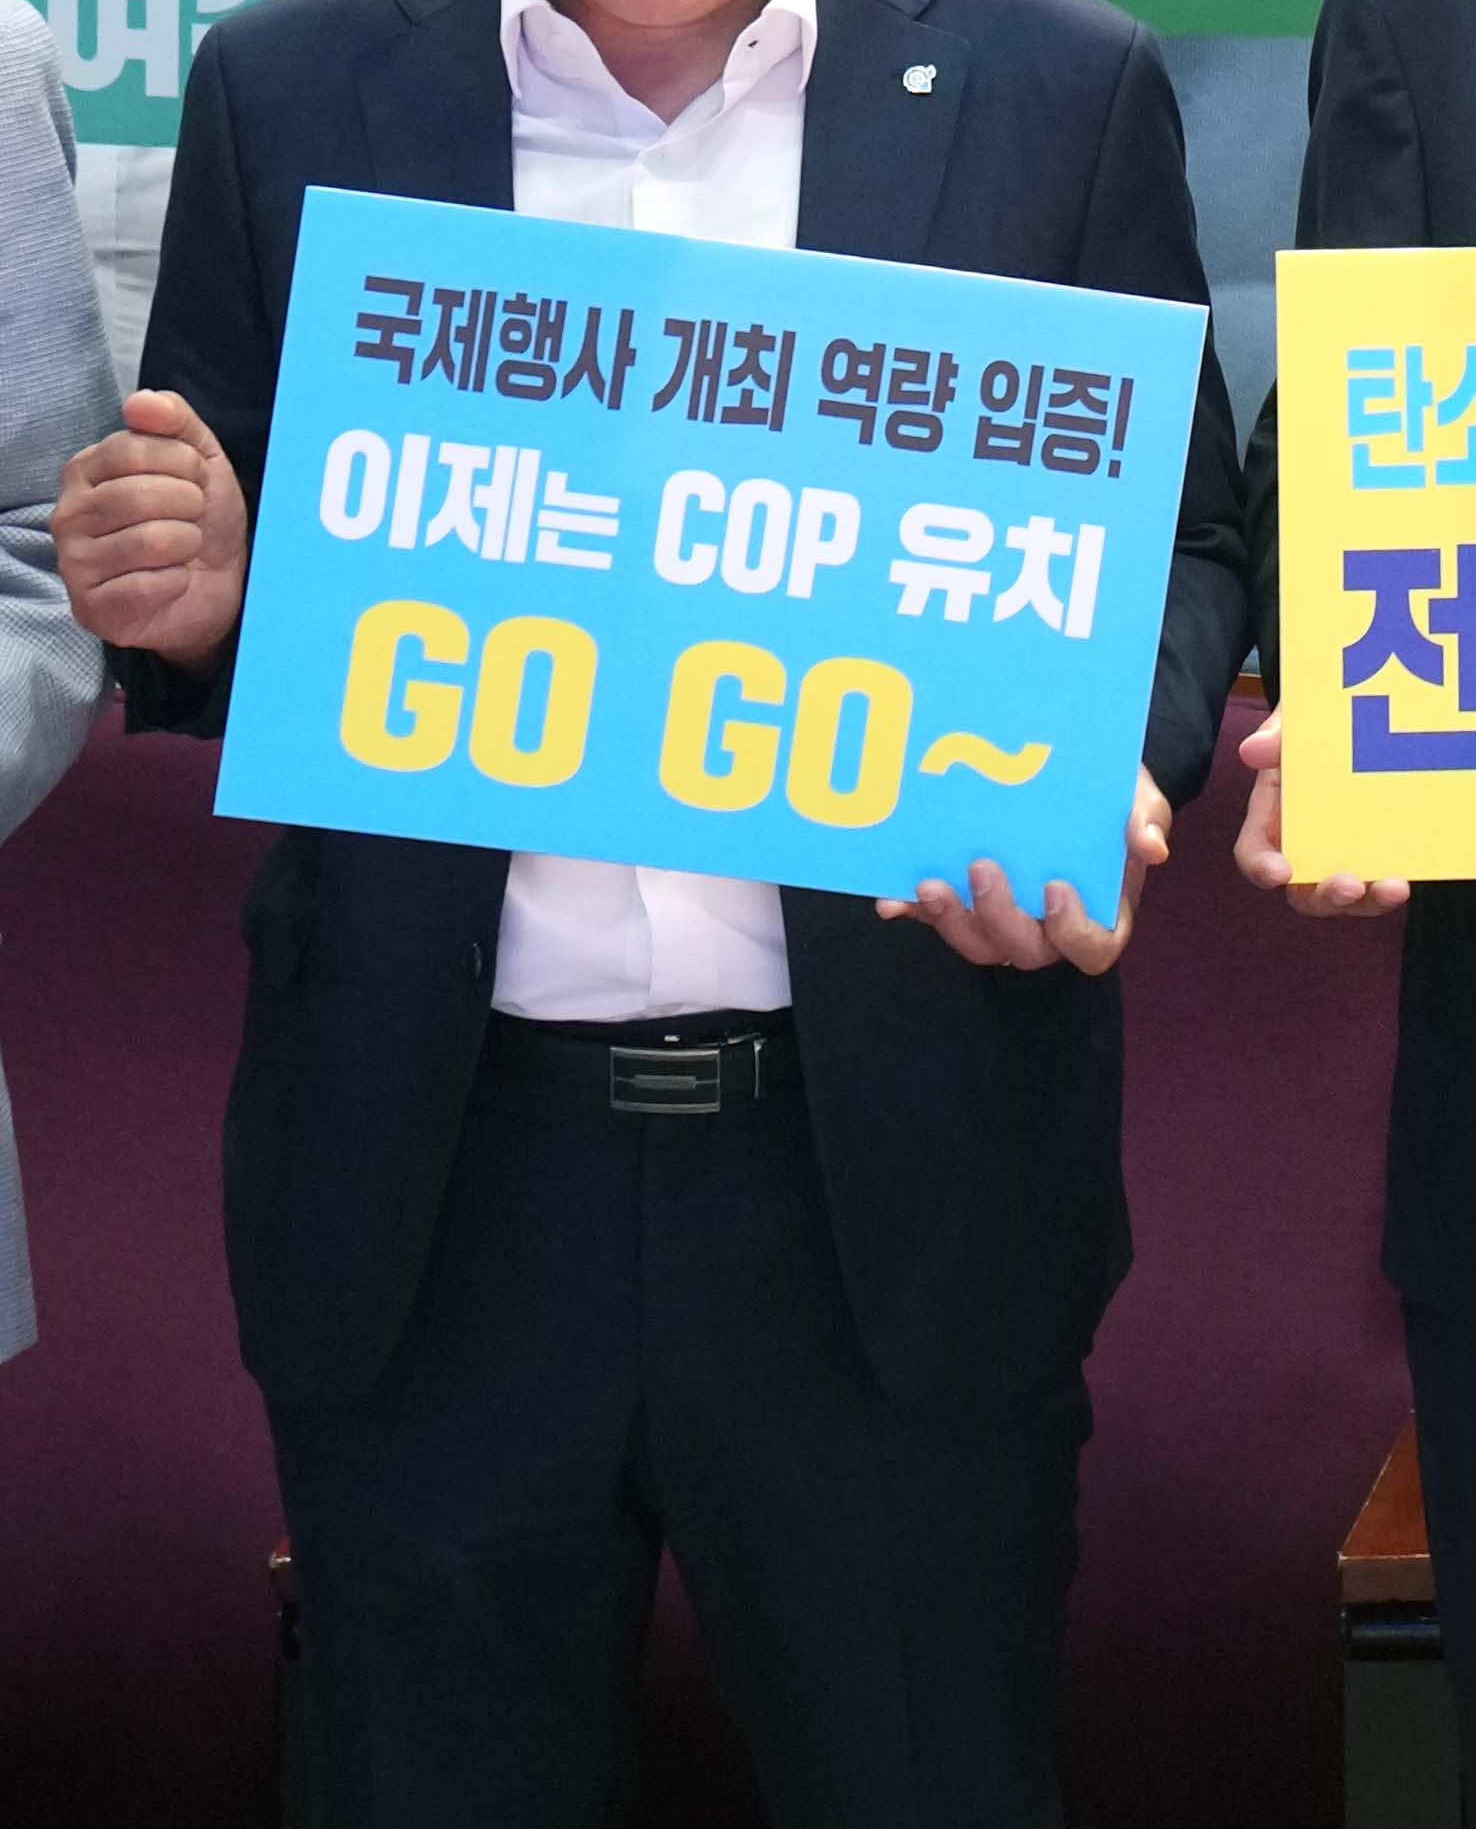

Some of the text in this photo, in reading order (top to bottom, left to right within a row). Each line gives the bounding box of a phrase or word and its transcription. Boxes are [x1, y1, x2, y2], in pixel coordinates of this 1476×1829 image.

[353, 274, 1135, 480] 국제행사 개최 역량 입증!
[318, 427, 1106, 640] 이제는 COP 유치
[339, 598, 600, 788] GO
